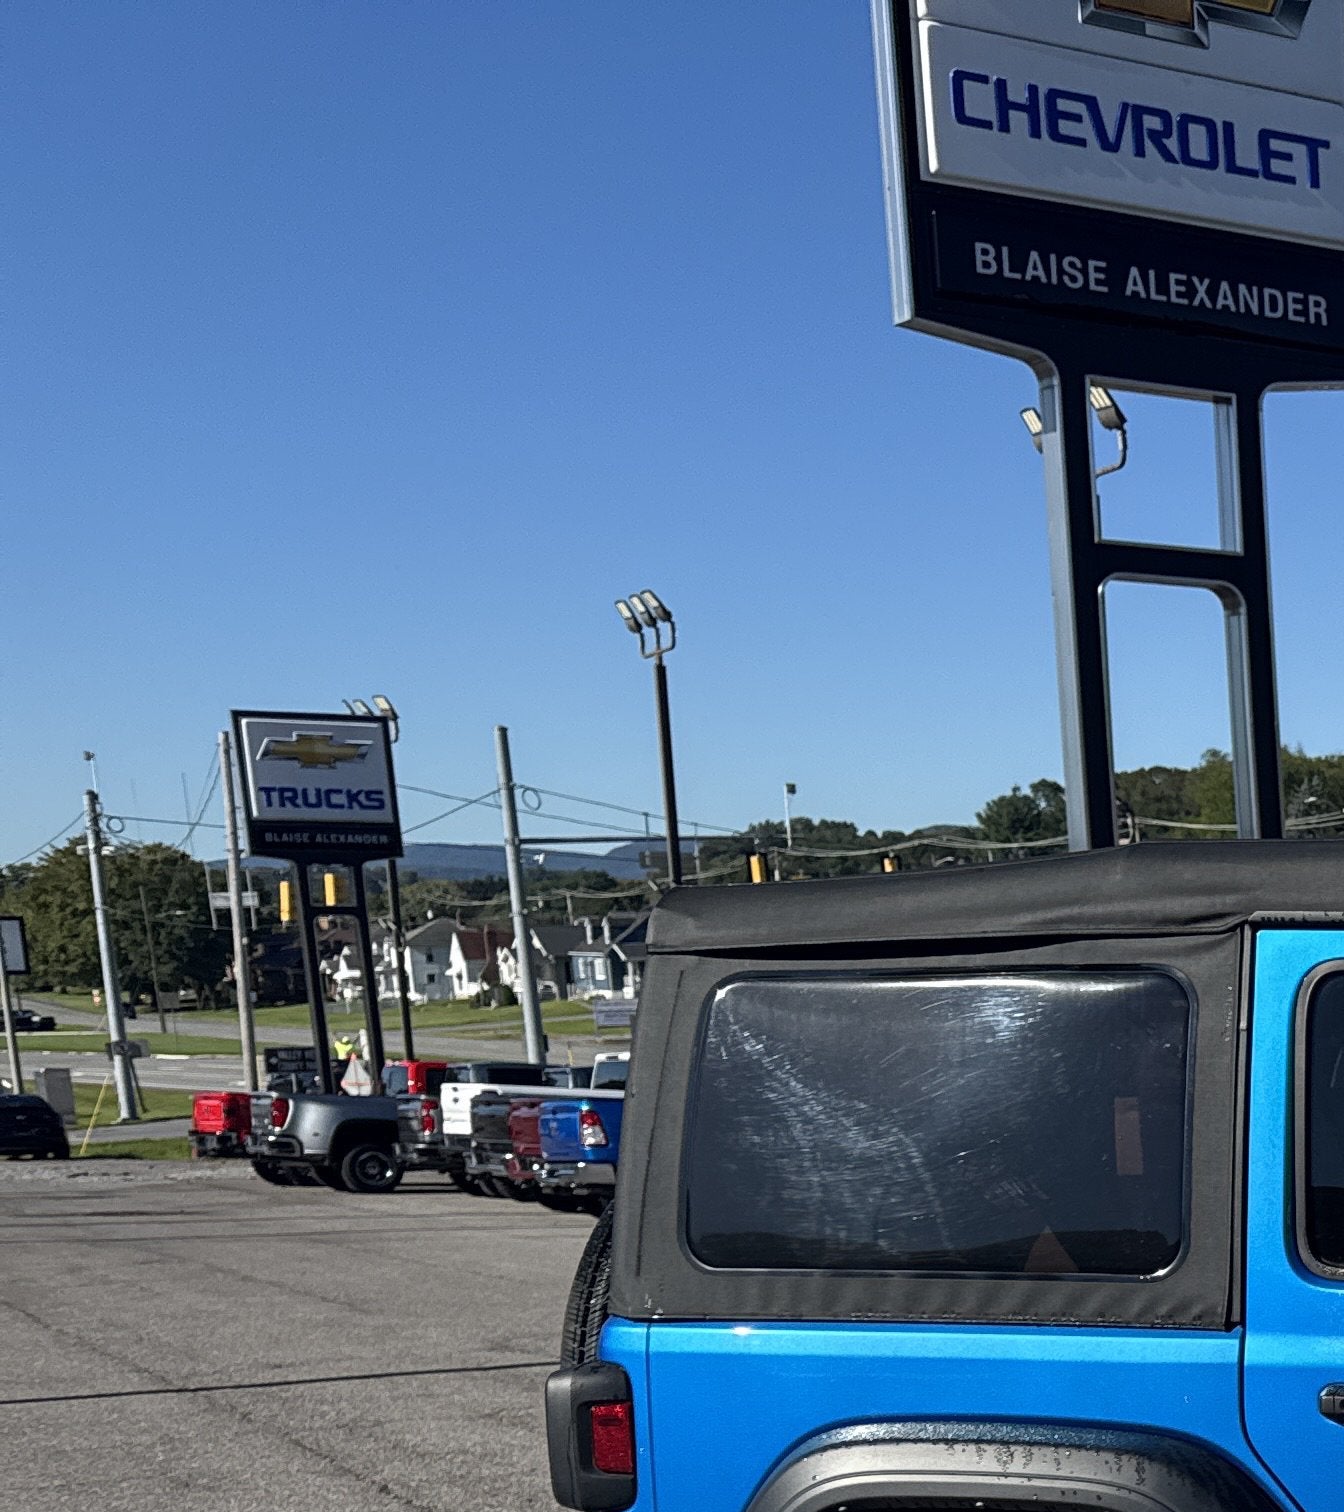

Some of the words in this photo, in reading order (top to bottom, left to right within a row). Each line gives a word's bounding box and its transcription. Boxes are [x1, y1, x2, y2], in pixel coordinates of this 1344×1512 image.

[950, 68, 1331, 190] CHEVROLET
[974, 241, 1109, 294] BLAISE
[1125, 266, 1329, 327] ALEXANDER
[258, 786, 386, 811] TRUCKS
[264, 832, 310, 843] BLAISE
[314, 832, 389, 845] ALEXANDER
